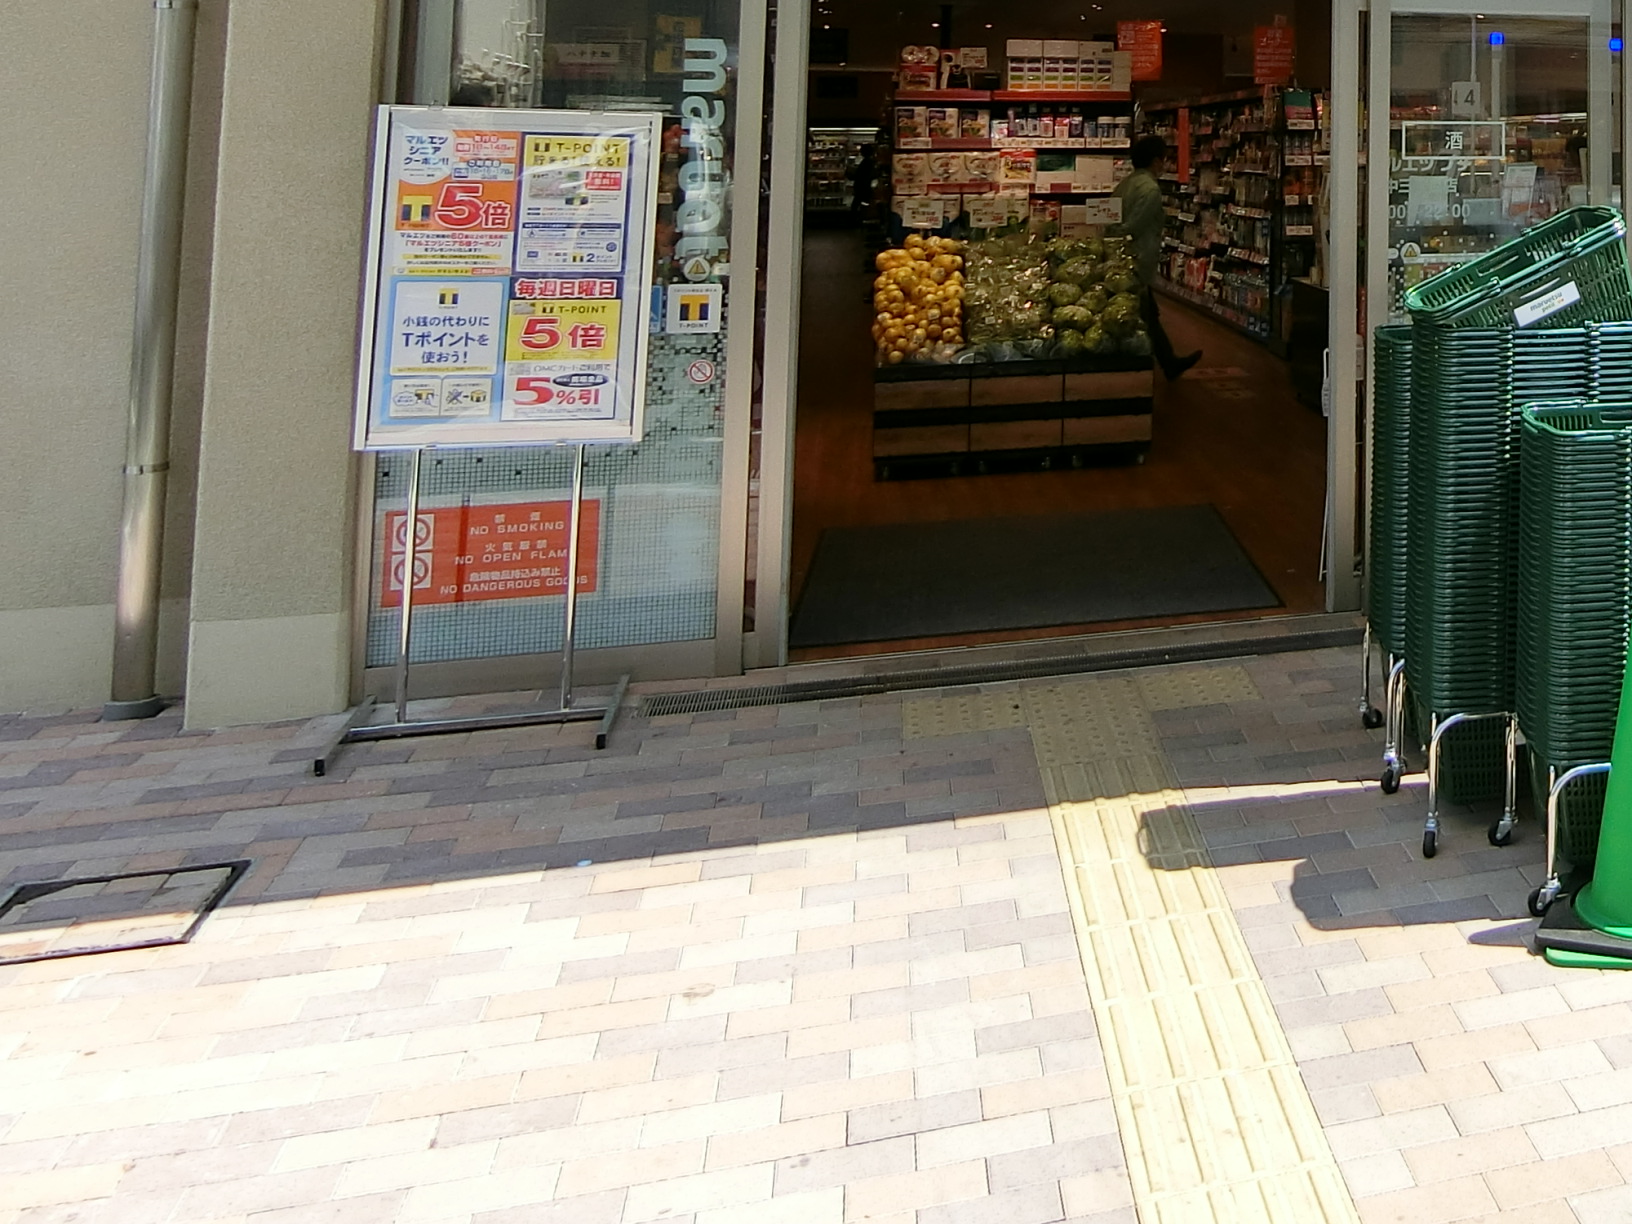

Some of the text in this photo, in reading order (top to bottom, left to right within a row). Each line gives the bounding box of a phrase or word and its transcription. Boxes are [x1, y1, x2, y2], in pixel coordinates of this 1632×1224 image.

[1464, 89, 1475, 106] 4
[405, 135, 449, 145] マルエツ
[1445, 131, 1464, 150] 酒
[409, 146, 442, 155] シニア
[435, 183, 511, 230] 5倍
[515, 278, 617, 299] 毎週日曜日
[558, 305, 607, 314] T-POINT
[1530, 291, 1563, 312] maruetsu
[402, 316, 490, 327] 小銭の代わりに
[402, 331, 490, 347] Tポイントを
[519, 317, 607, 351] 5倍
[421, 351, 468, 364] 使おう!
[514, 377, 601, 406] 5%引
[469, 520, 565, 536] NO SMOKING
[454, 549, 568, 565] NO OPEN FLAM
[440, 575, 588, 595] NO DANGEROUS GOOS
